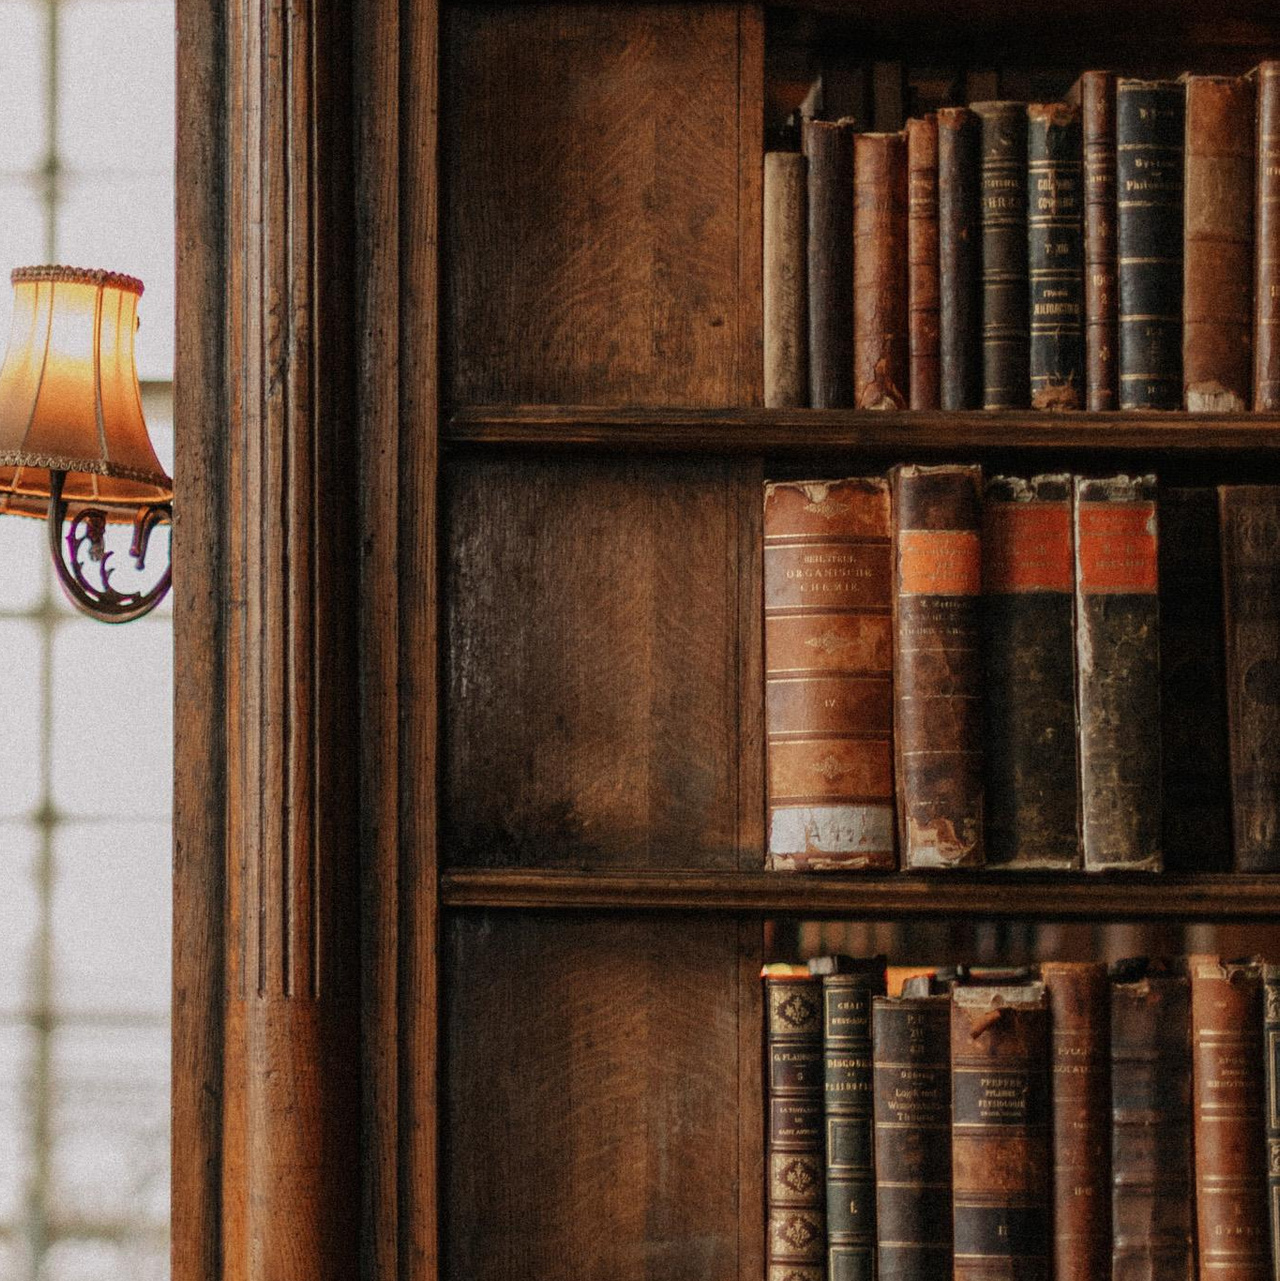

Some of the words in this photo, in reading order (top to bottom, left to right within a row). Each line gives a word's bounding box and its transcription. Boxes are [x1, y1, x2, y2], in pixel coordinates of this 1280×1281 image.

[786, 567, 873, 580] ORGANISCHE
[799, 582, 860, 594] CHEMIE
[827, 1059, 868, 1069] DISCOU
